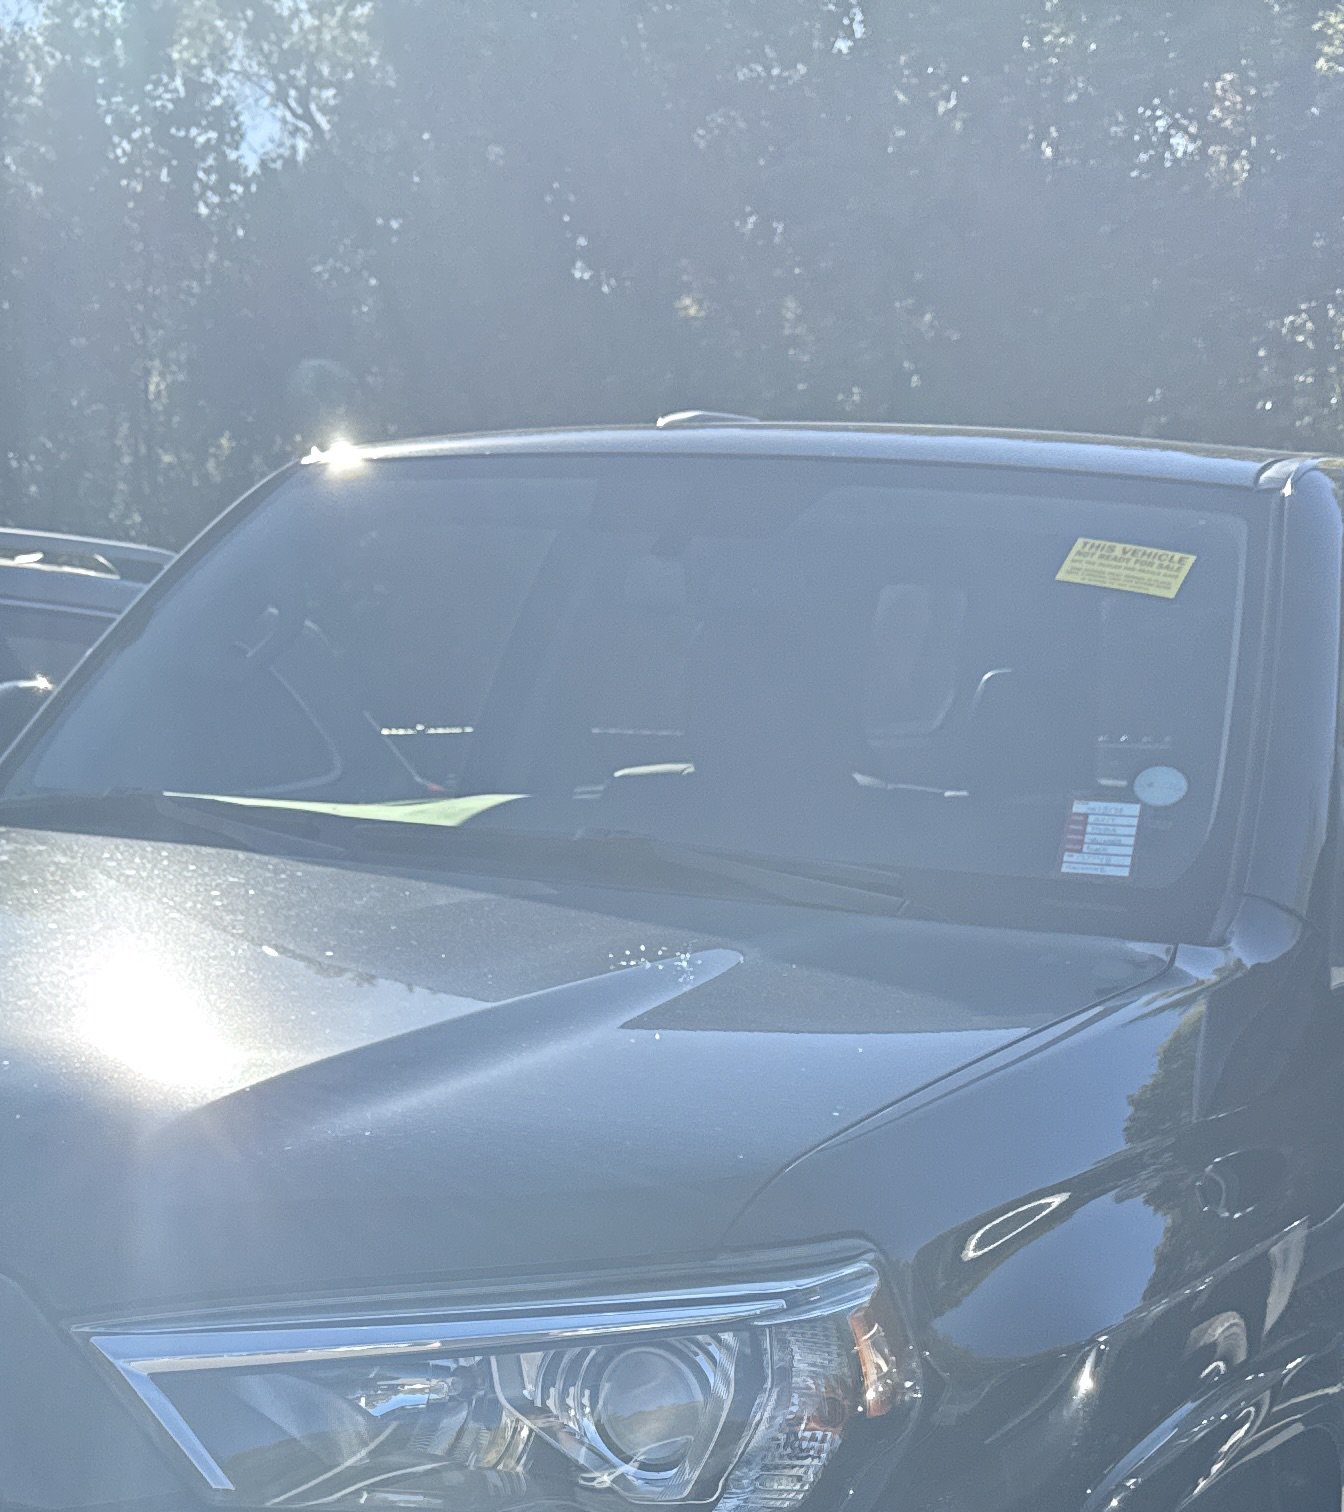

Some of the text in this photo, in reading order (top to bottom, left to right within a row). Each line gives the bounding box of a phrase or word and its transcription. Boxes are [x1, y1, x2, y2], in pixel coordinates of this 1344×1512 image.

[1075, 551, 1095, 560] NOT
[1097, 553, 1132, 564] READY
[1134, 557, 1155, 568] FOR
[1157, 562, 1184, 572] SALE
[1081, 541, 1190, 565] THIS VEHICLE
